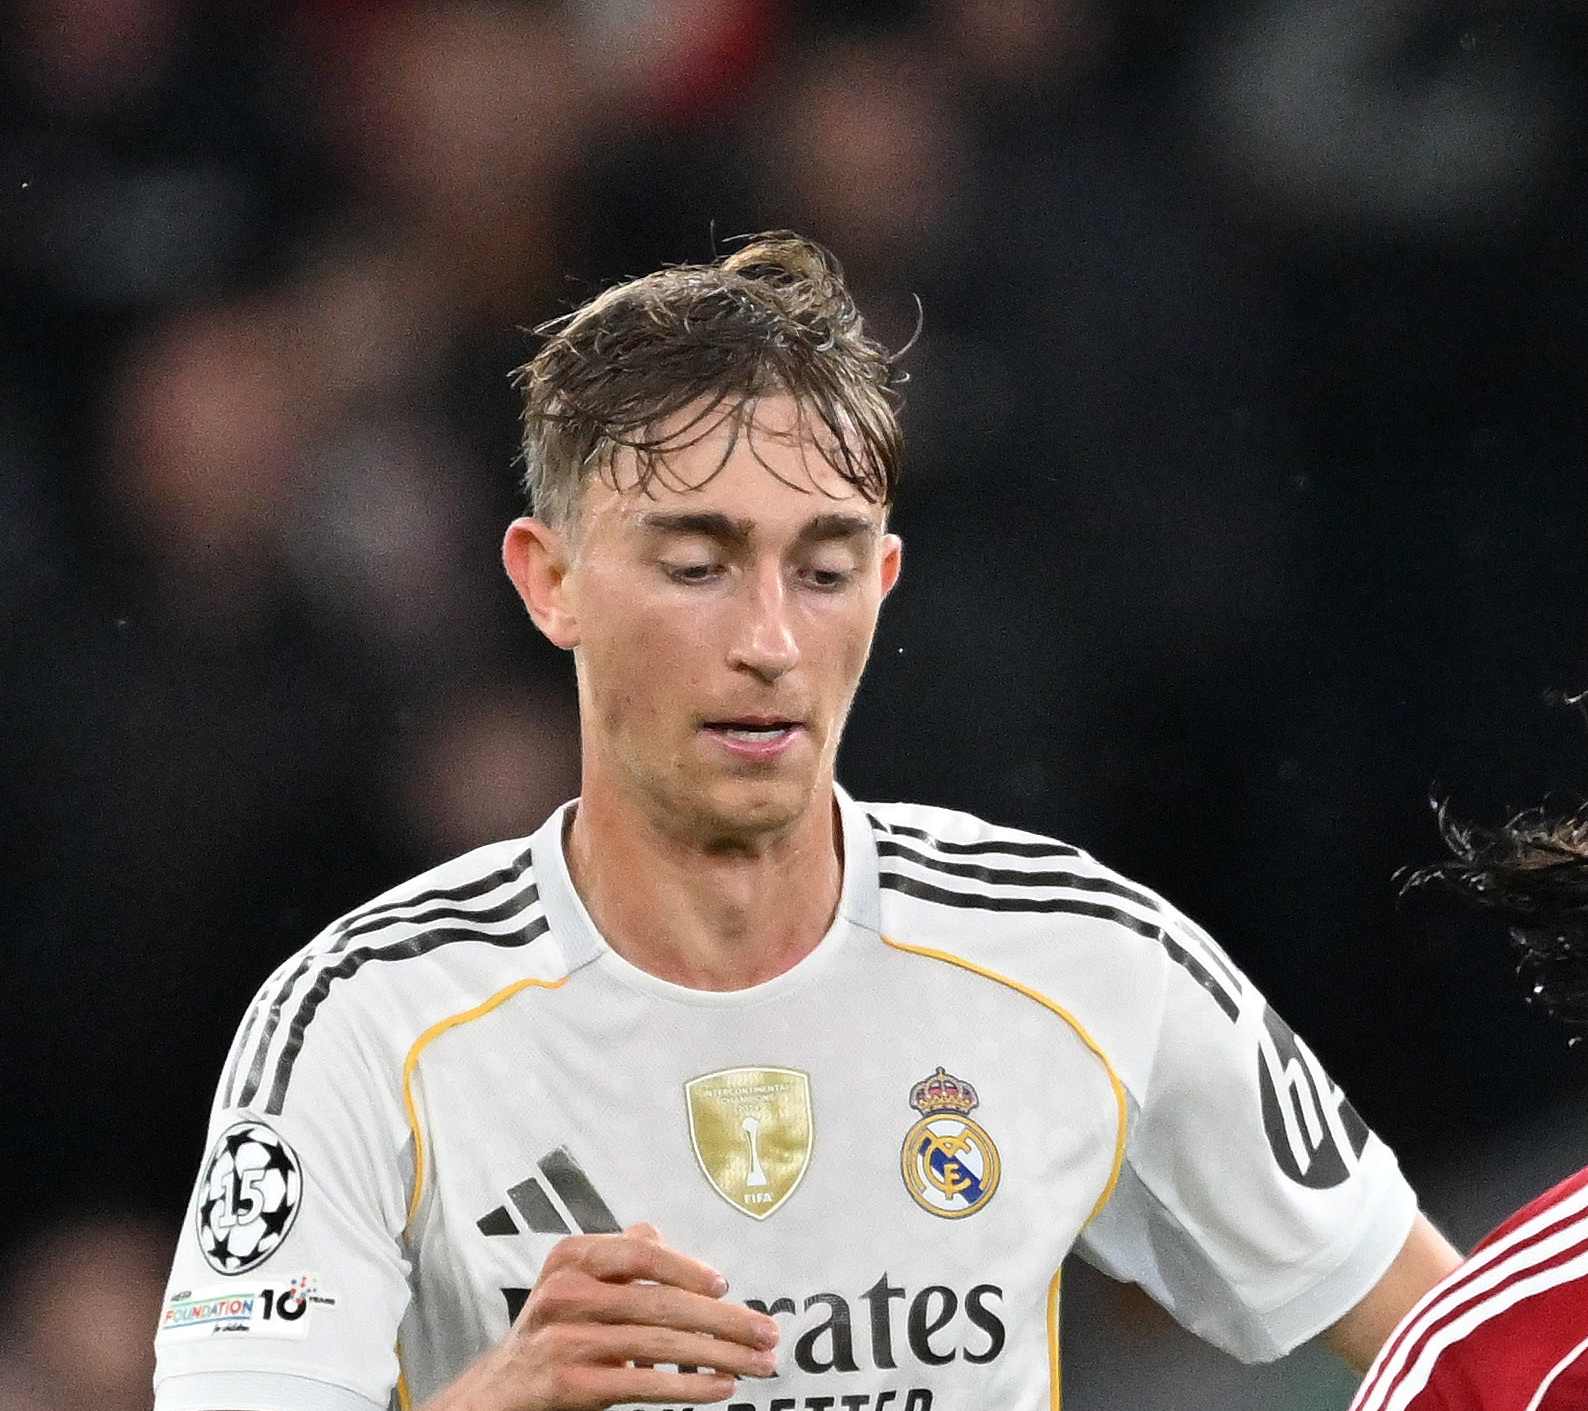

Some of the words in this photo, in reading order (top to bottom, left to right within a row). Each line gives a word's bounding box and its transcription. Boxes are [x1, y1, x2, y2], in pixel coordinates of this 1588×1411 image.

[219, 1168, 266, 1228] 15
[744, 1192, 772, 1204] FIFA
[165, 1299, 254, 1323] FOUNDATION
